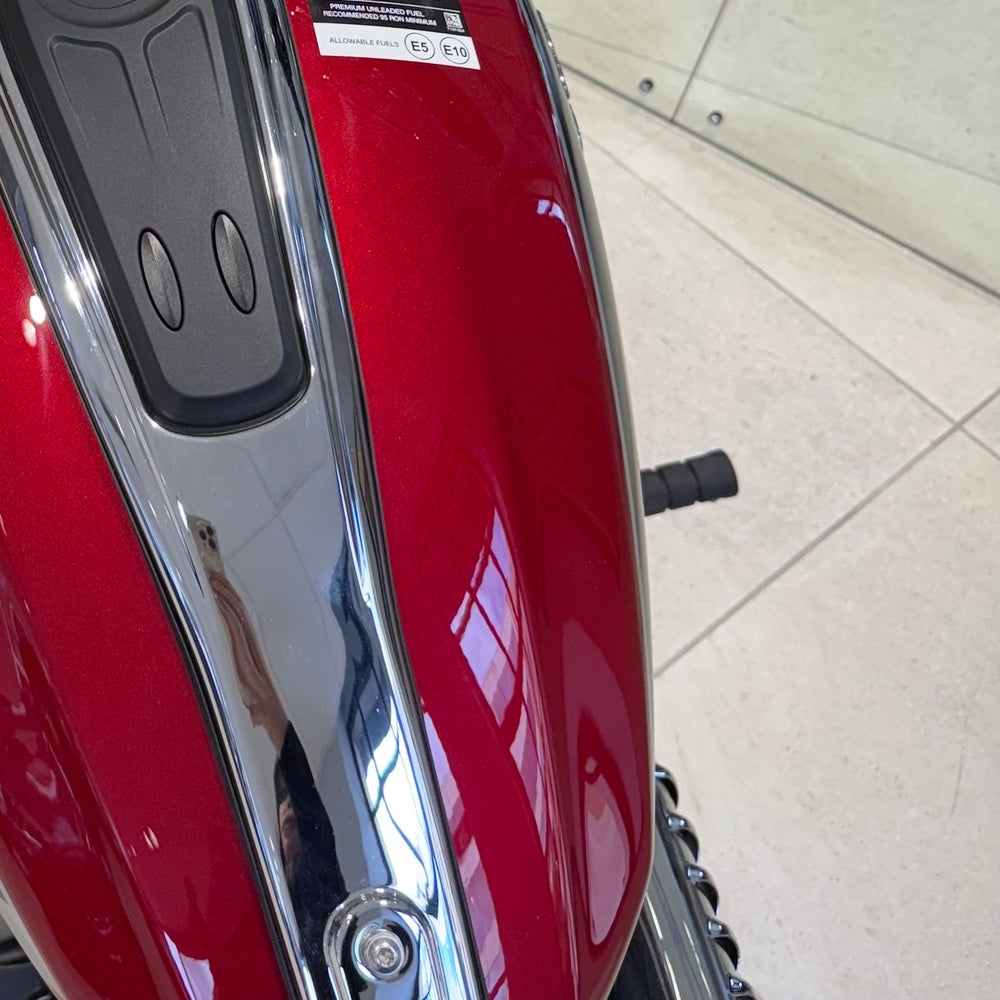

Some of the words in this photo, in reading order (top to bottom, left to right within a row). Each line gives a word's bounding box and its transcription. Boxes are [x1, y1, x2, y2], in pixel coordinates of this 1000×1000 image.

[323, 10, 379, 20] RECOMMENDED
[405, 17, 438, 27] MINIMUM
[329, 3, 365, 12] PREMIUM
[366, 5, 405, 16] UNLEADED
[406, 9, 425, 18] FUEL
[329, 37, 374, 46] ALLOWABLE
[376, 39, 400, 48] FUELS
[410, 40, 429, 53] E5
[443, 44, 467, 58] E10
